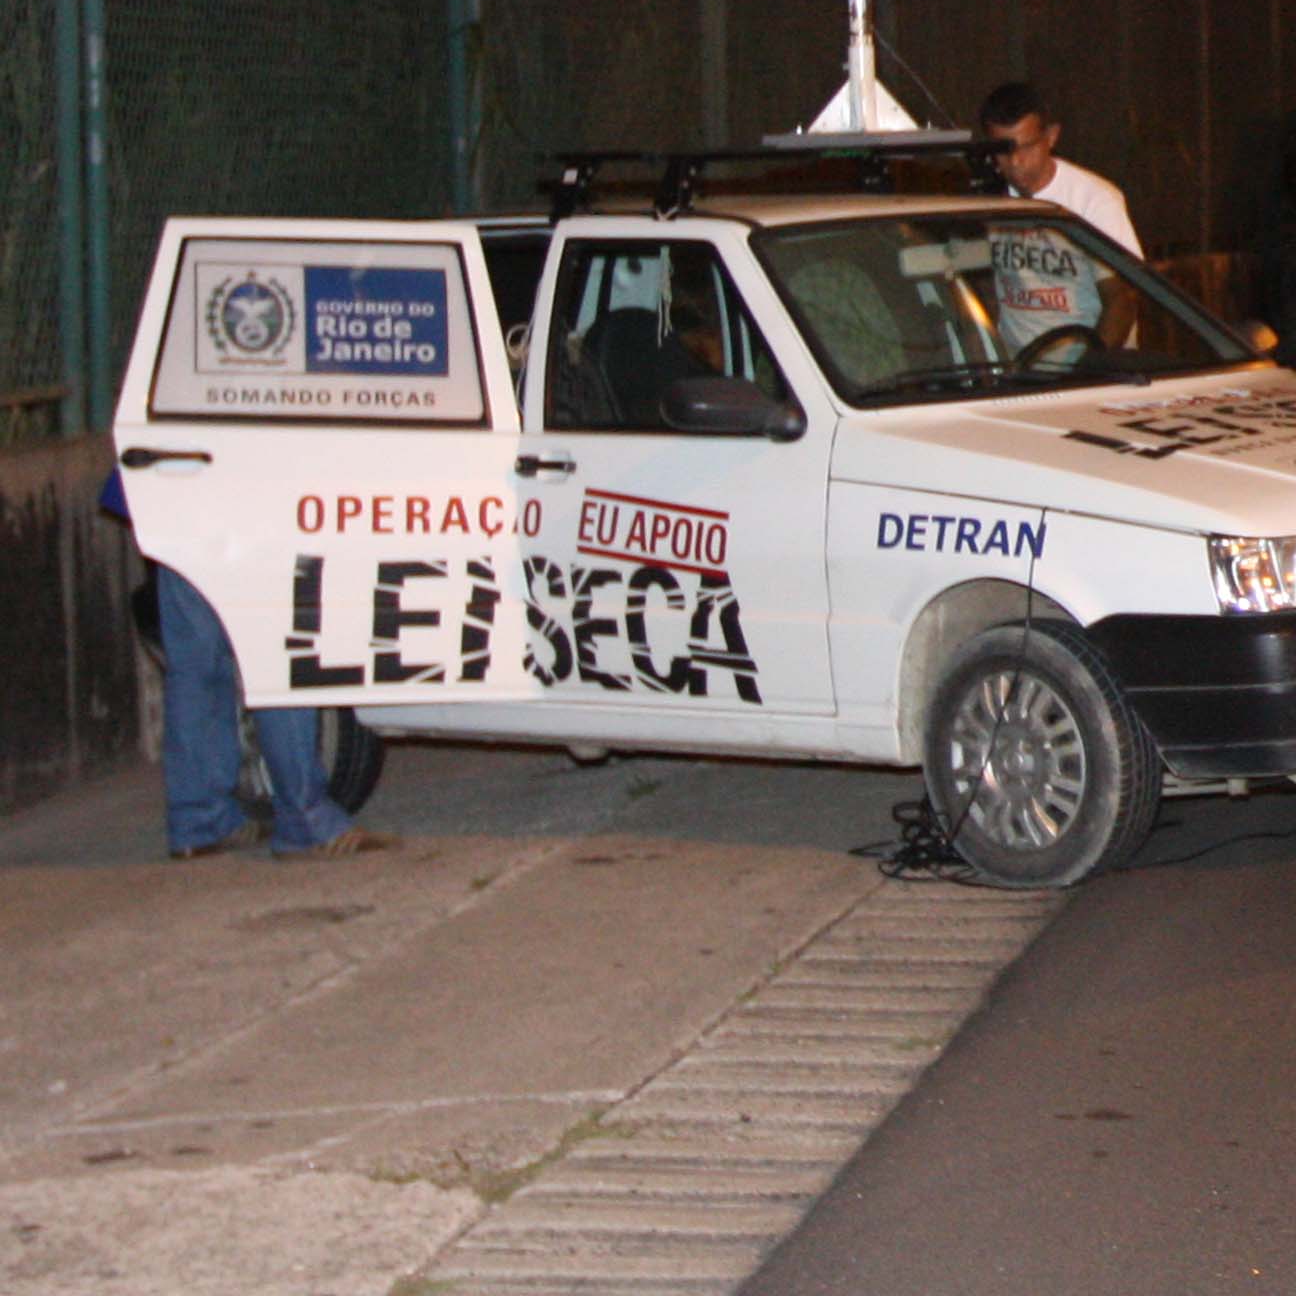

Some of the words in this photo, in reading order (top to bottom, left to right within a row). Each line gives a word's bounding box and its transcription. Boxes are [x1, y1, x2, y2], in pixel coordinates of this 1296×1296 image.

[316, 300, 403, 316] GOVERNO
[408, 302, 435, 317] DO
[316, 315, 368, 338] Rio
[373, 317, 412, 339] de
[316, 339, 436, 363] Janeiro
[206, 387, 332, 406] SOMANDO
[343, 389, 436, 409] FORÇAS
[297, 495, 542, 538] OPERAÇO
[578, 500, 619, 546] EU
[625, 510, 727, 566] APOIO
[877, 512, 1047, 559] DETRAN
[285, 554, 501, 690] LEI
[522, 556, 763, 706] SECA
